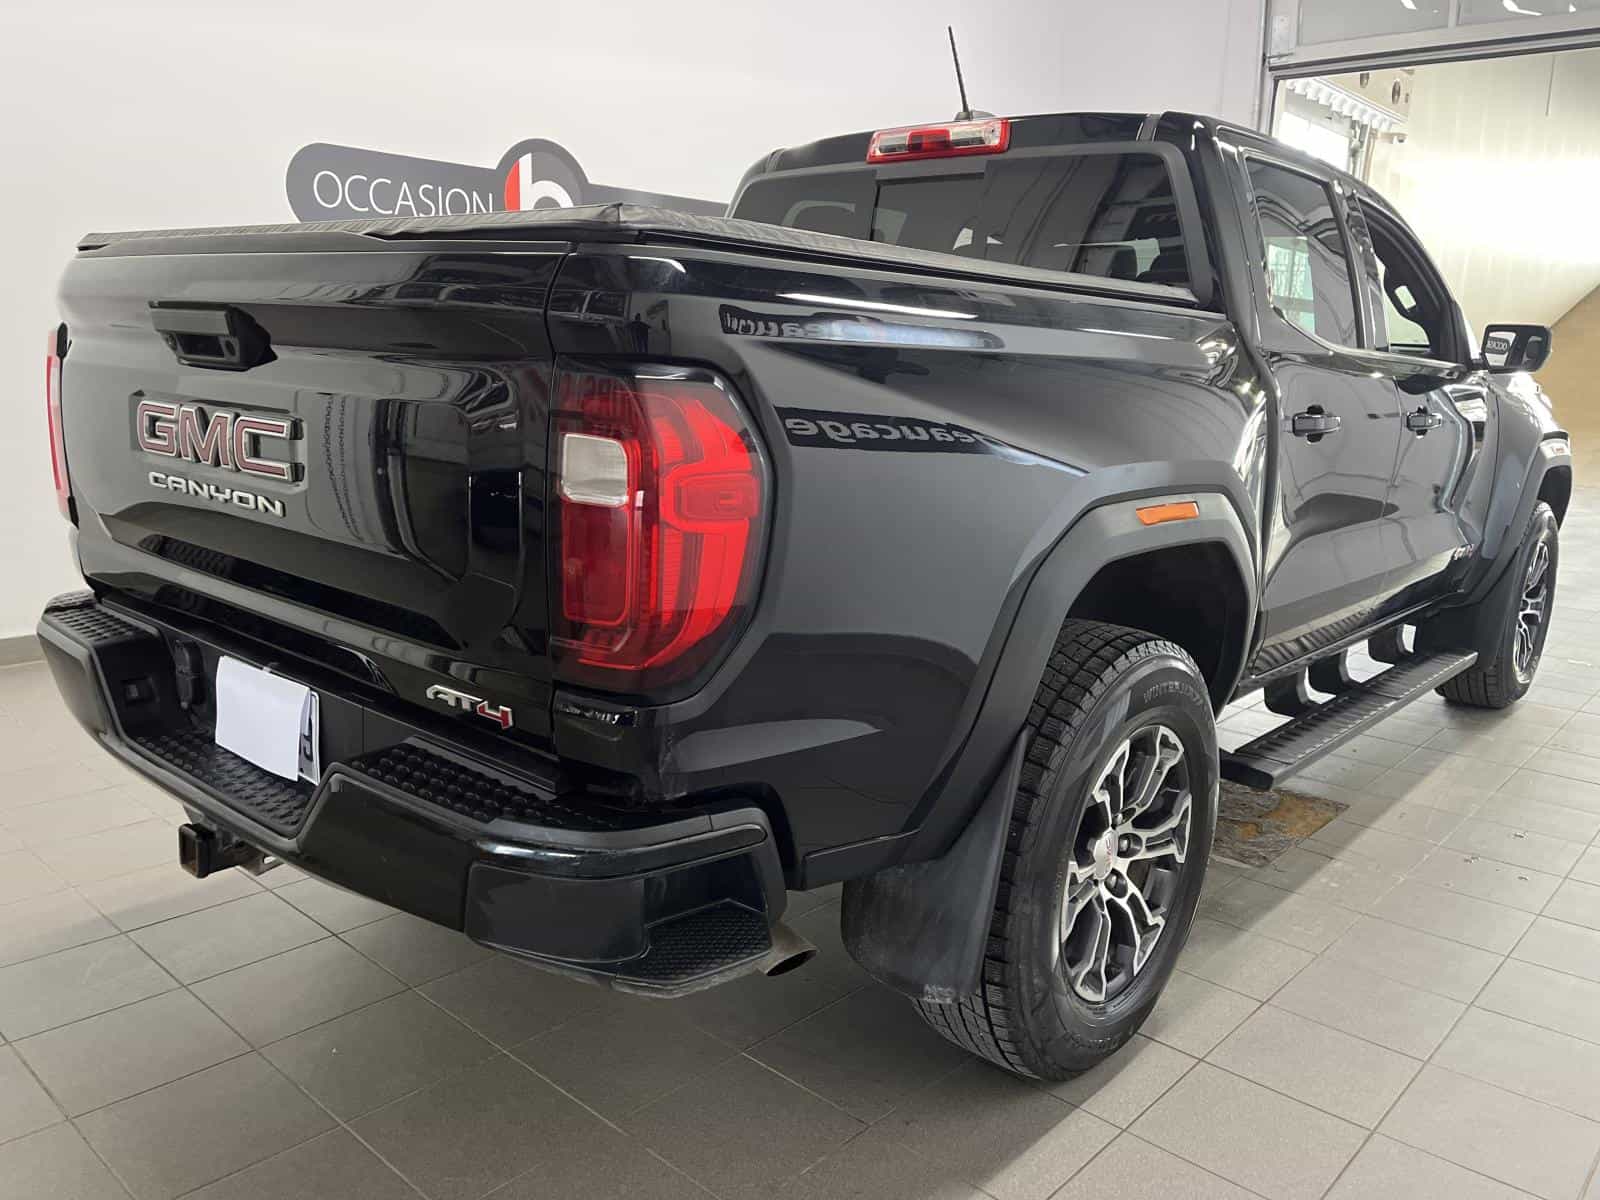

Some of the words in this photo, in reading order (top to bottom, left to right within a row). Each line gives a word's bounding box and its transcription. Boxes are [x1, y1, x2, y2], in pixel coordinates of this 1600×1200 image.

[313, 170, 494, 217] OCCASION
[137, 400, 302, 482] GMC
[148, 471, 286, 517] CANYON
[425, 684, 513, 729] AT4
